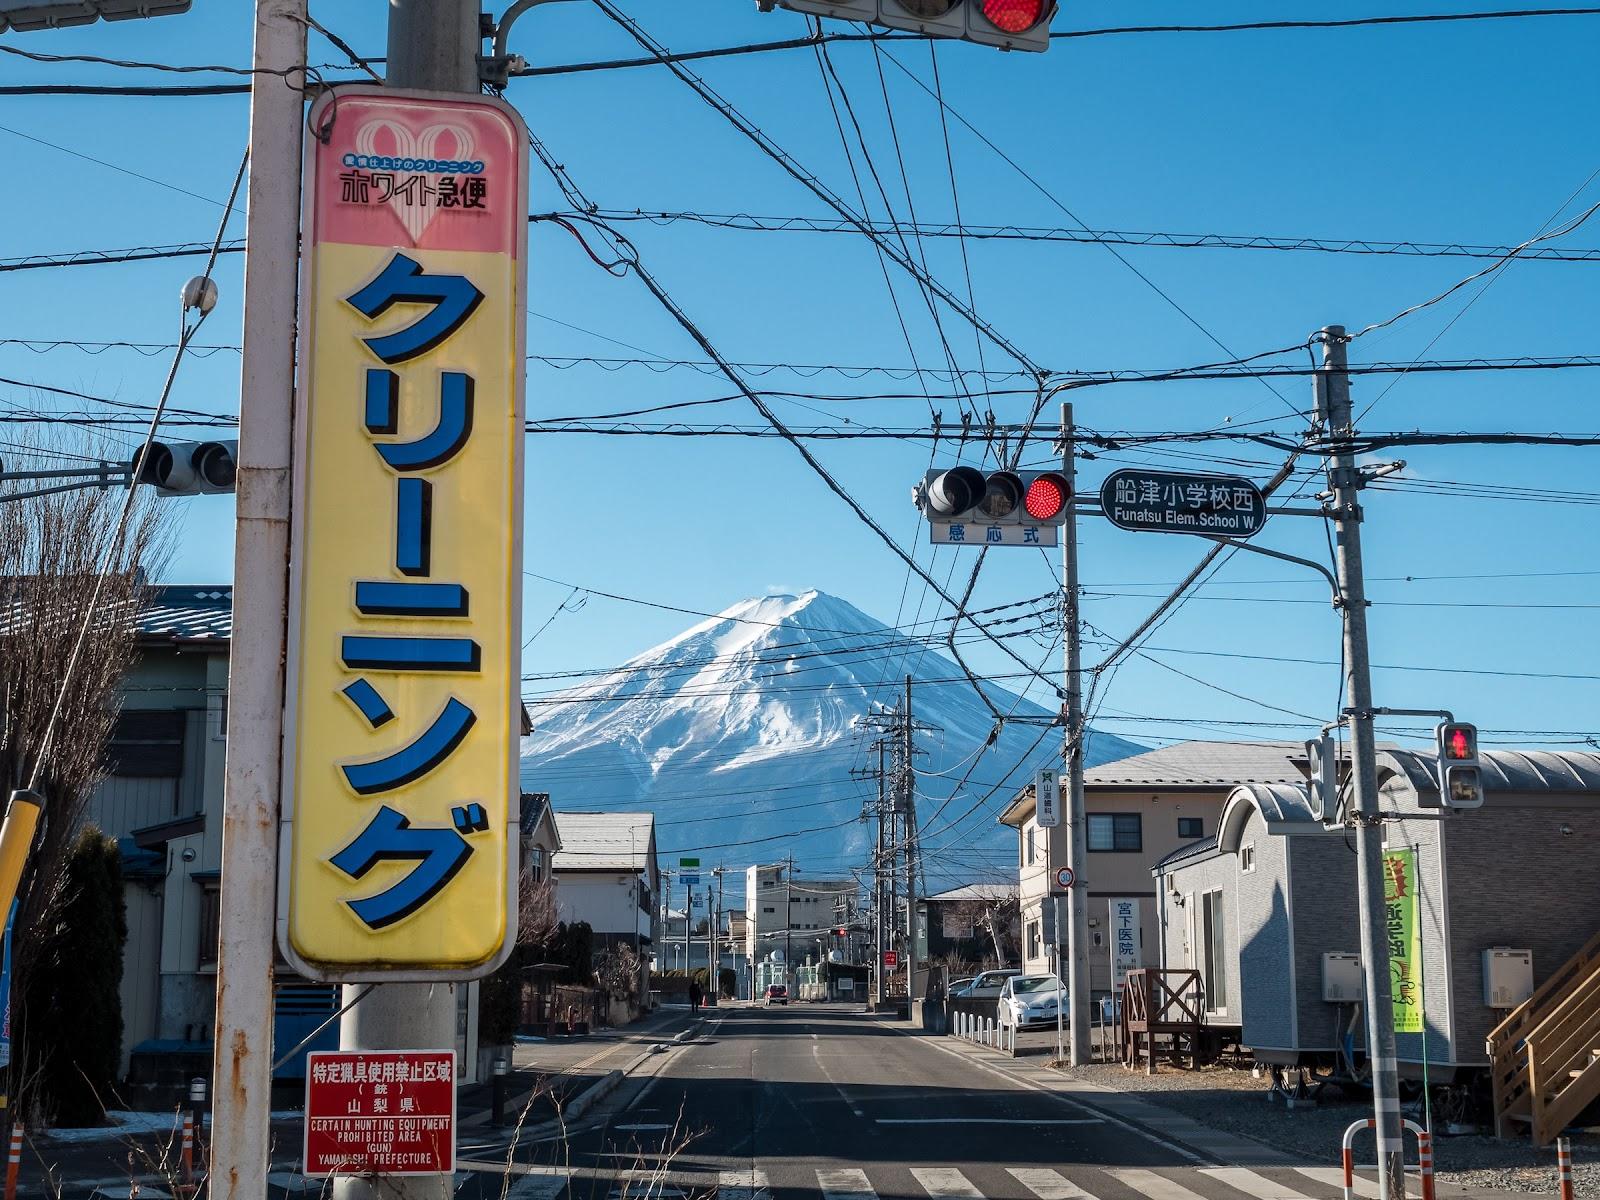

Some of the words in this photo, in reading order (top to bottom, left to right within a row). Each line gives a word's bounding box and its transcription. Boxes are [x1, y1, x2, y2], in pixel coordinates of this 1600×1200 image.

[339, 170, 487, 209] ホワイト急便
[1114, 478, 1254, 512] 船津小学校西
[1114, 507, 1162, 523] Funatsu
[949, 523, 1039, 543] 感応式
[328, 252, 489, 930] クリーニング
[1060, 873, 1071, 883] 30
[1117, 902, 1134, 956] 宮下医院
[312, 1060, 451, 1084] 特定猟具使用禁止区域
[347, 1097, 414, 1114] 山梨県
[311, 1119, 350, 1131] CERTAIN
[354, 1119, 394, 1131] HUNTING
[398, 1118, 450, 1130] EQUIPMENT
[337, 1131, 394, 1142] PROHIBITED
[398, 1131, 421, 1142] AREA
[367, 1143, 392, 1153] (GUN)
[374, 1153, 432, 1164] PREFECTURE
